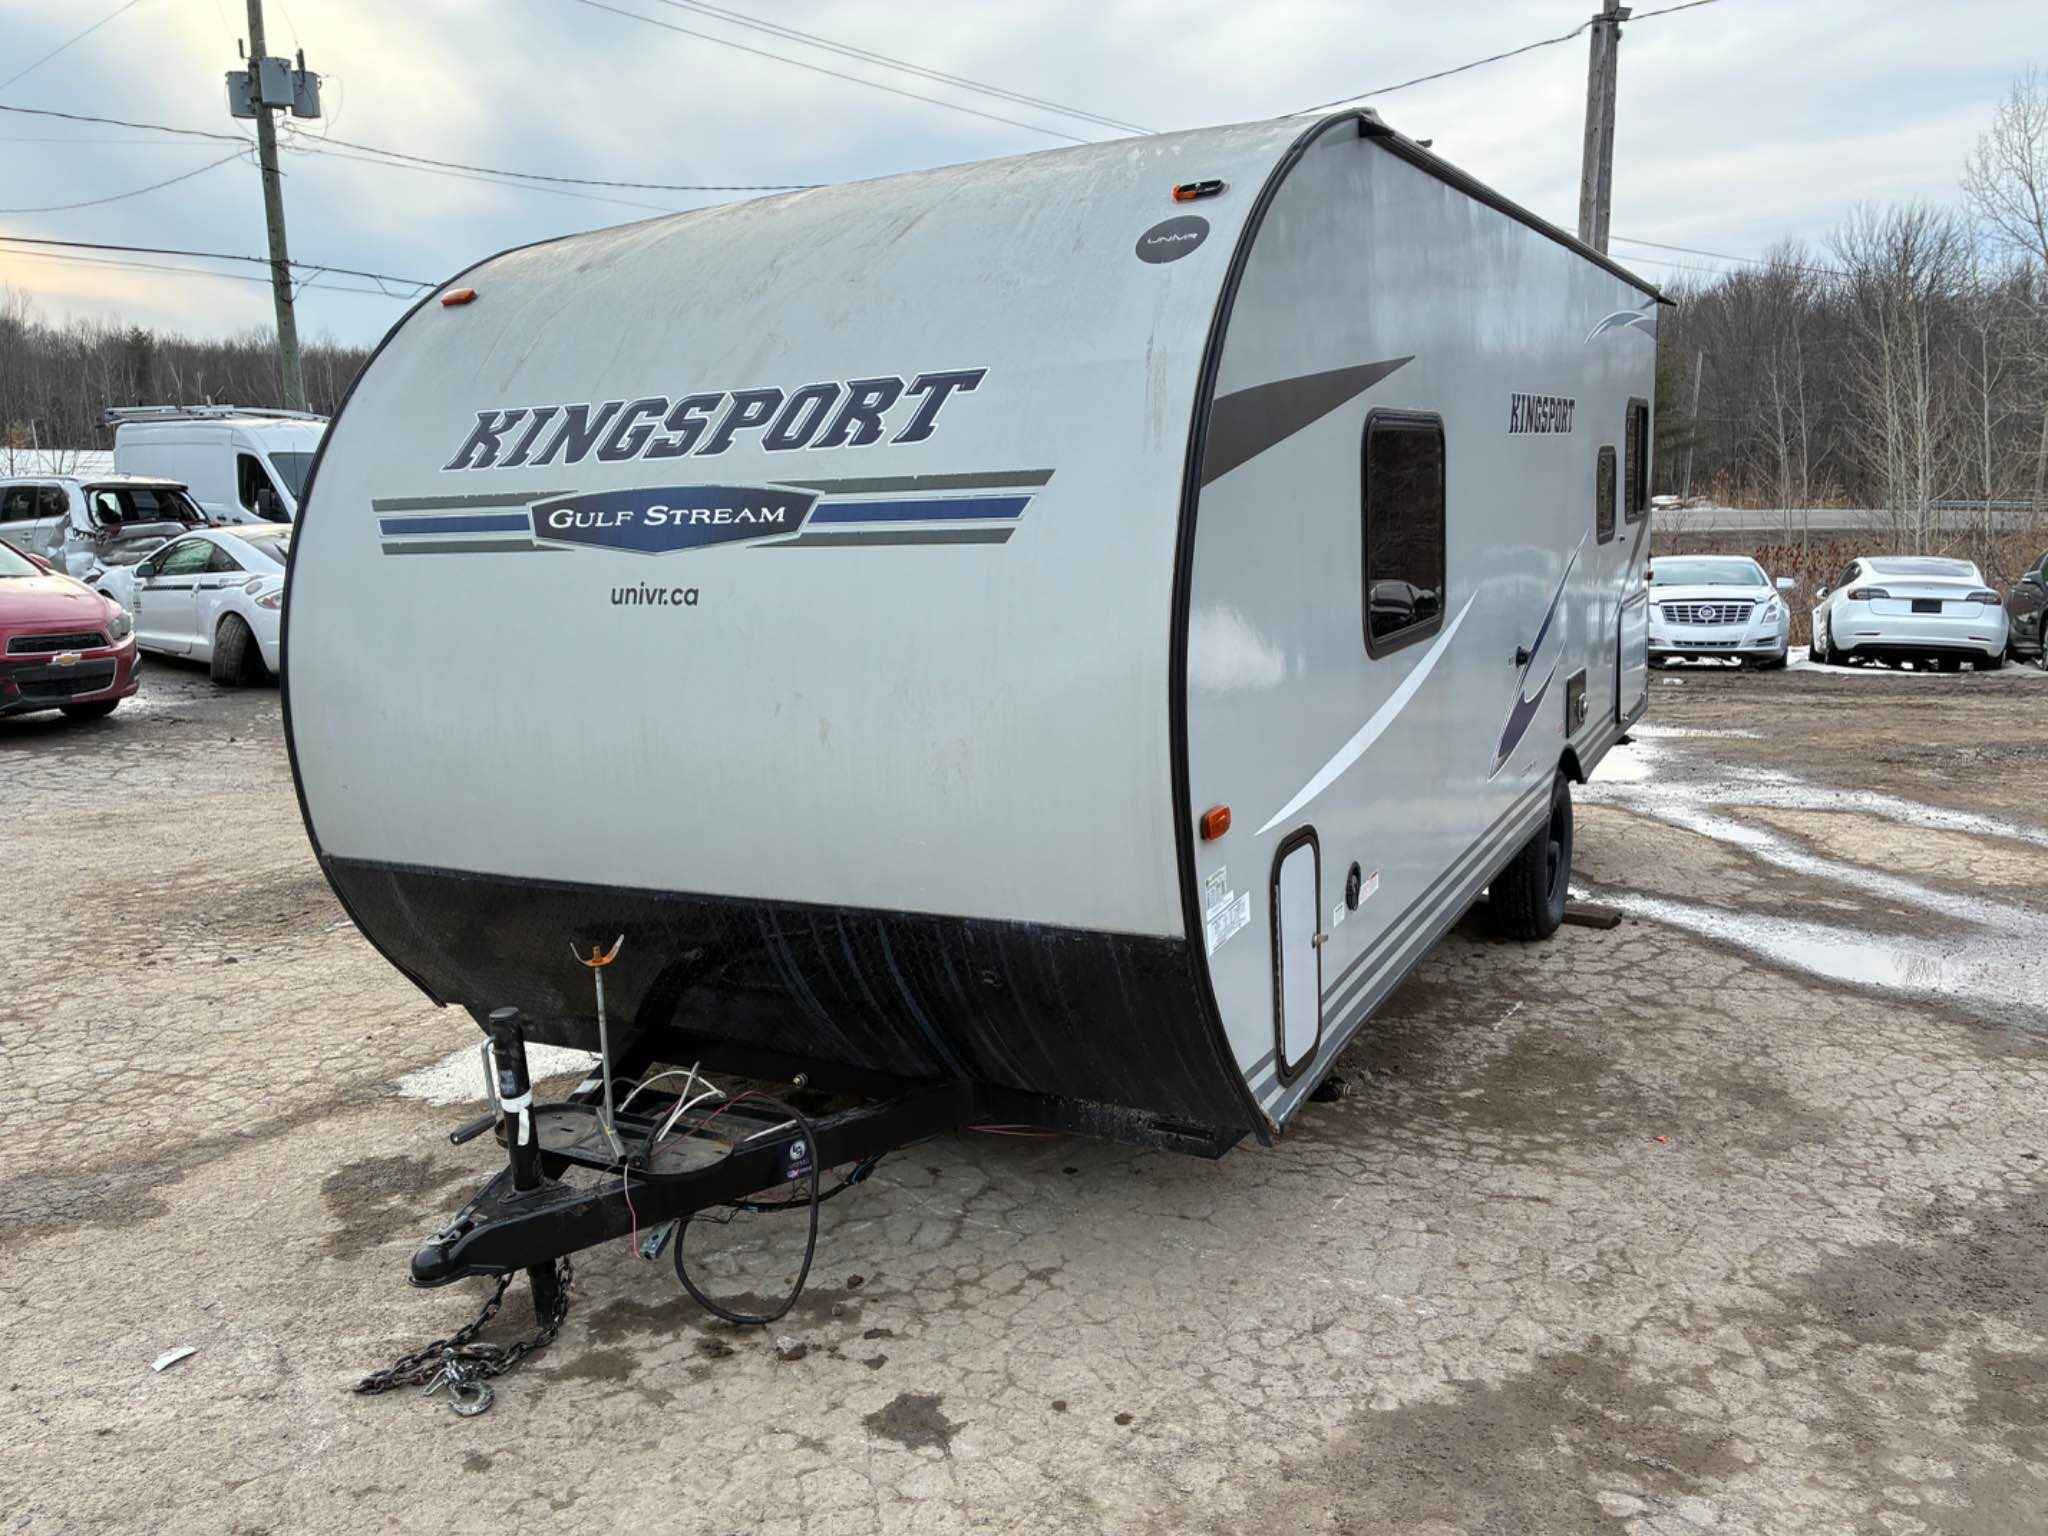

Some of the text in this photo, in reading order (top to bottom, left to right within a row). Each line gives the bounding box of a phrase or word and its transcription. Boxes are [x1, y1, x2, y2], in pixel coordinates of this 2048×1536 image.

[442, 366, 988, 471] KINGSPORT
[1507, 391, 1576, 435] KINGSPORT
[548, 505, 786, 529] GULF STREAM
[610, 581, 699, 606] univr.ca
